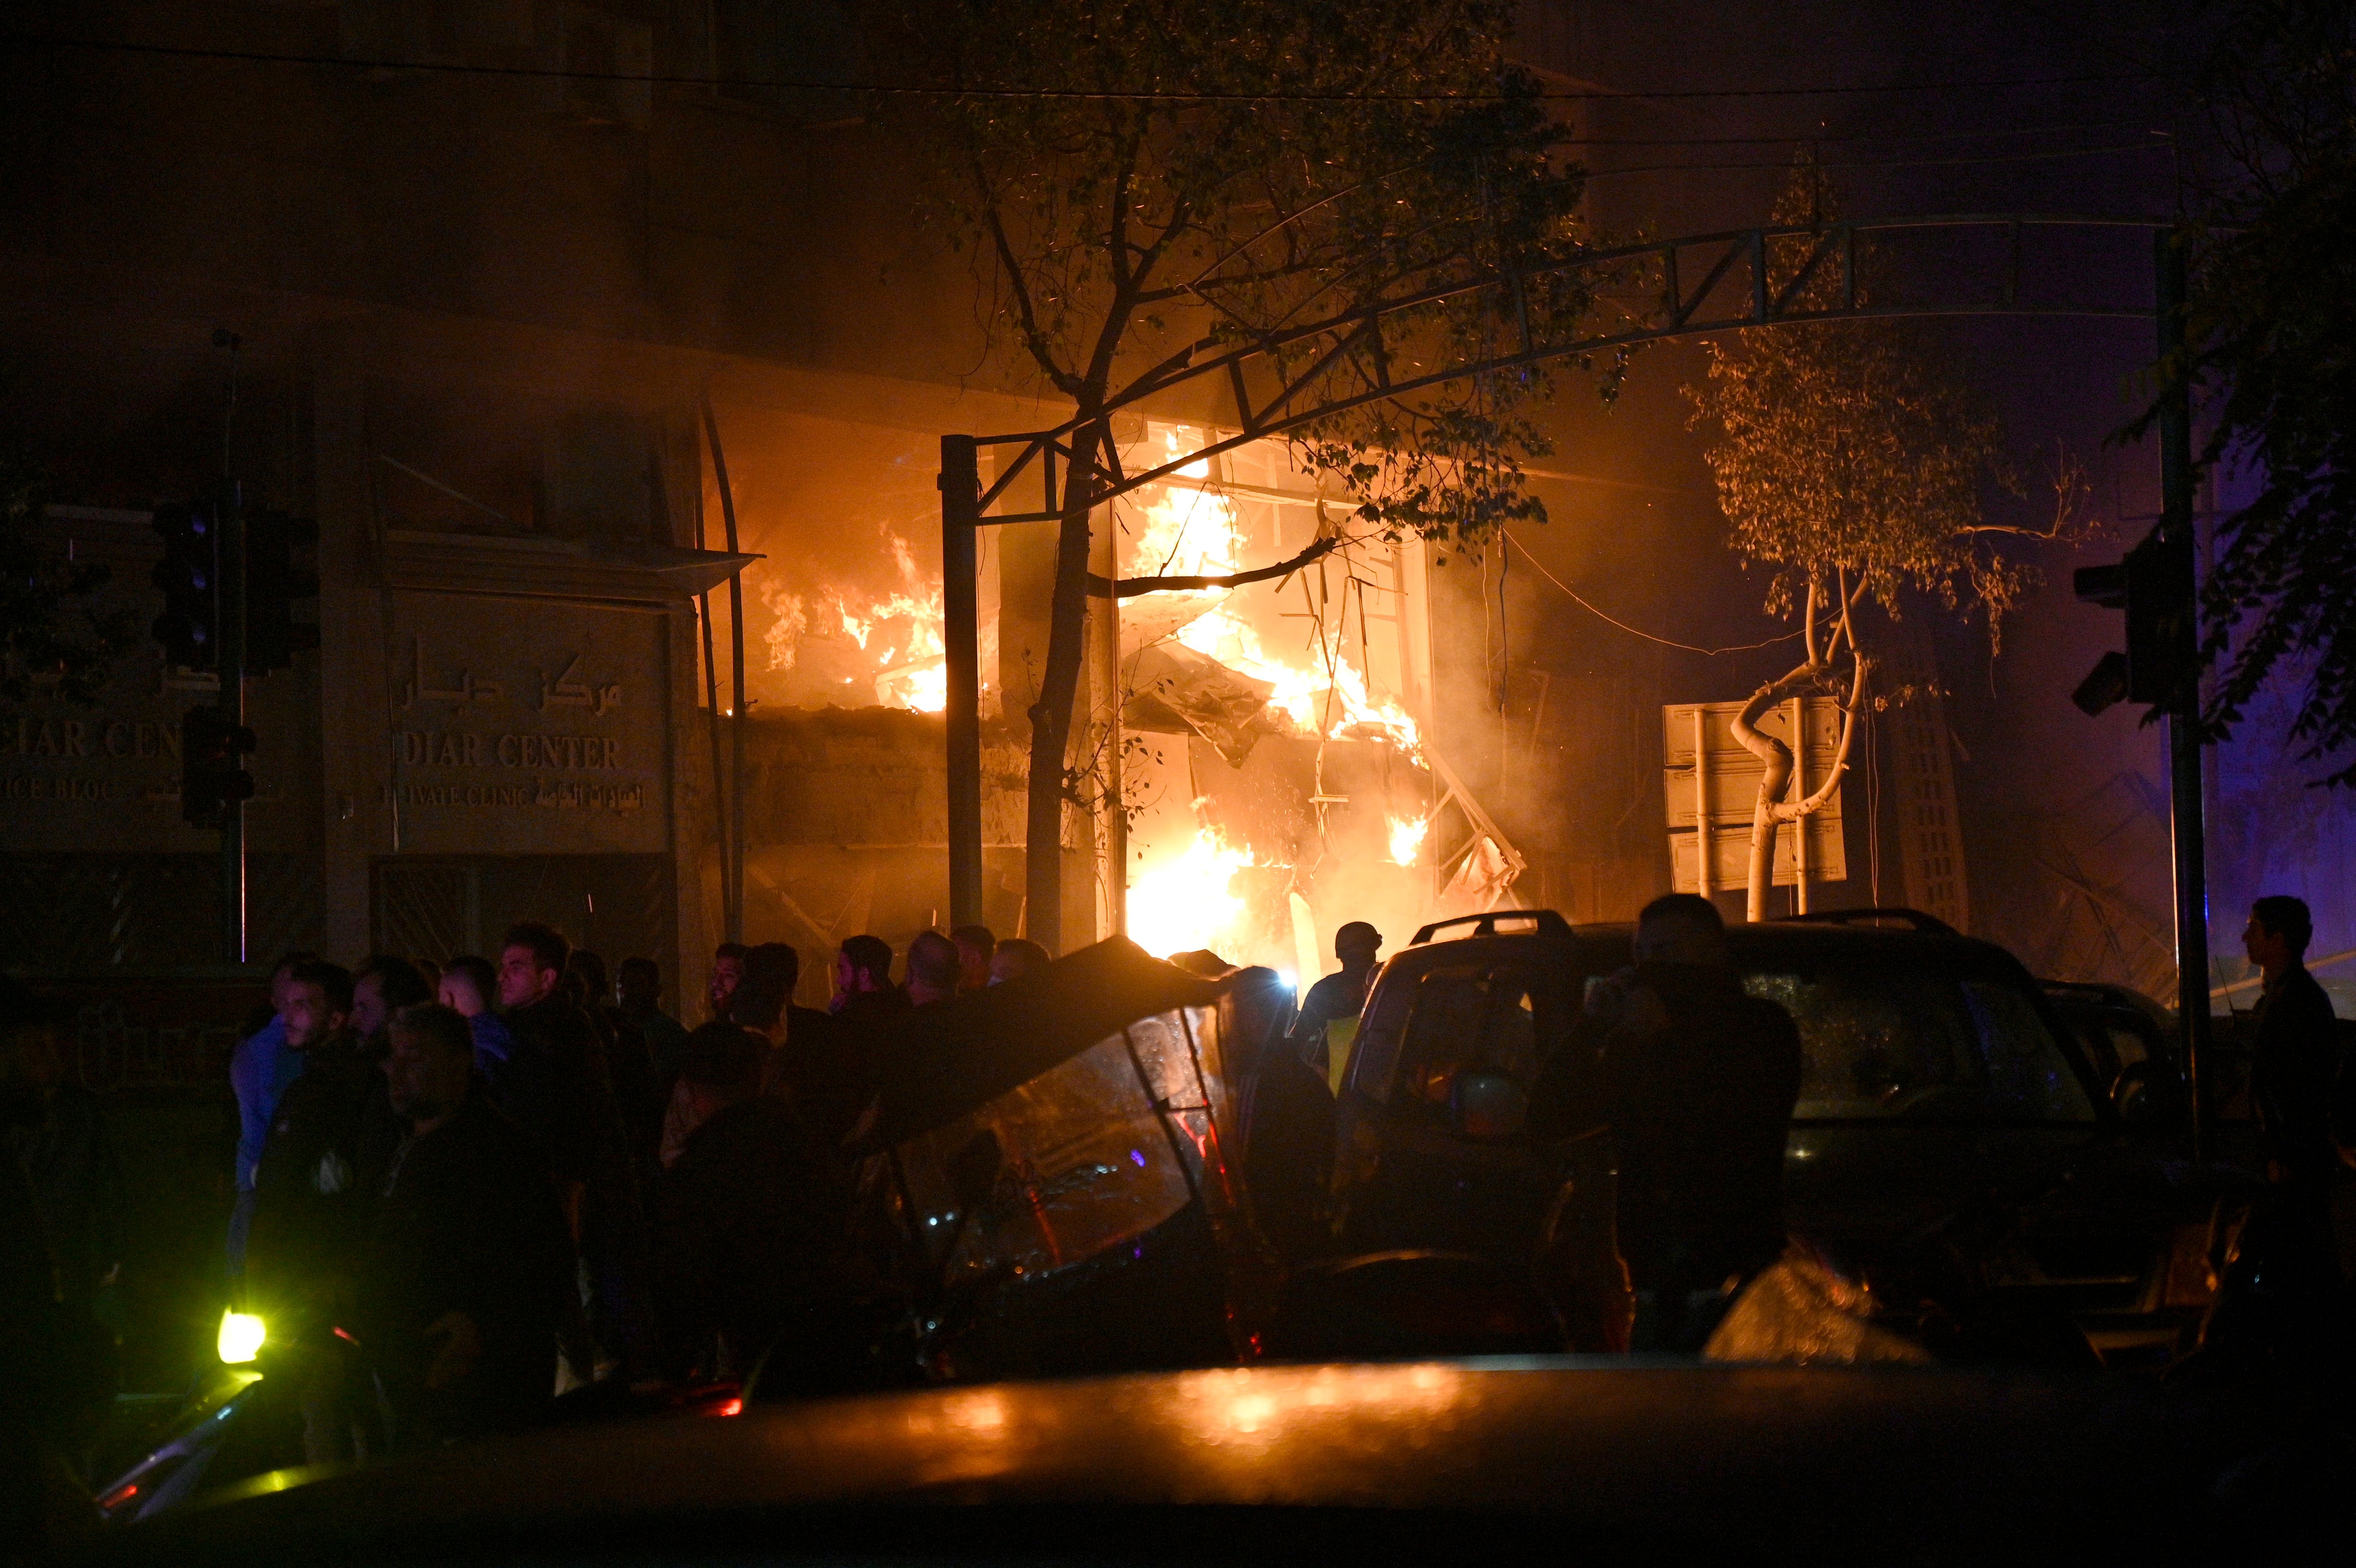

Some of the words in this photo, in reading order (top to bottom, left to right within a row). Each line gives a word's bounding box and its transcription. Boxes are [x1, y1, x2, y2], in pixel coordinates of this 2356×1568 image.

[401, 635, 504, 716] ديار
[535, 653, 622, 717] مركز
[0, 718, 88, 757] IAR
[402, 731, 482, 767] DIAR
[496, 734, 622, 770] CENTER
[467, 784, 531, 806] CLINIC
